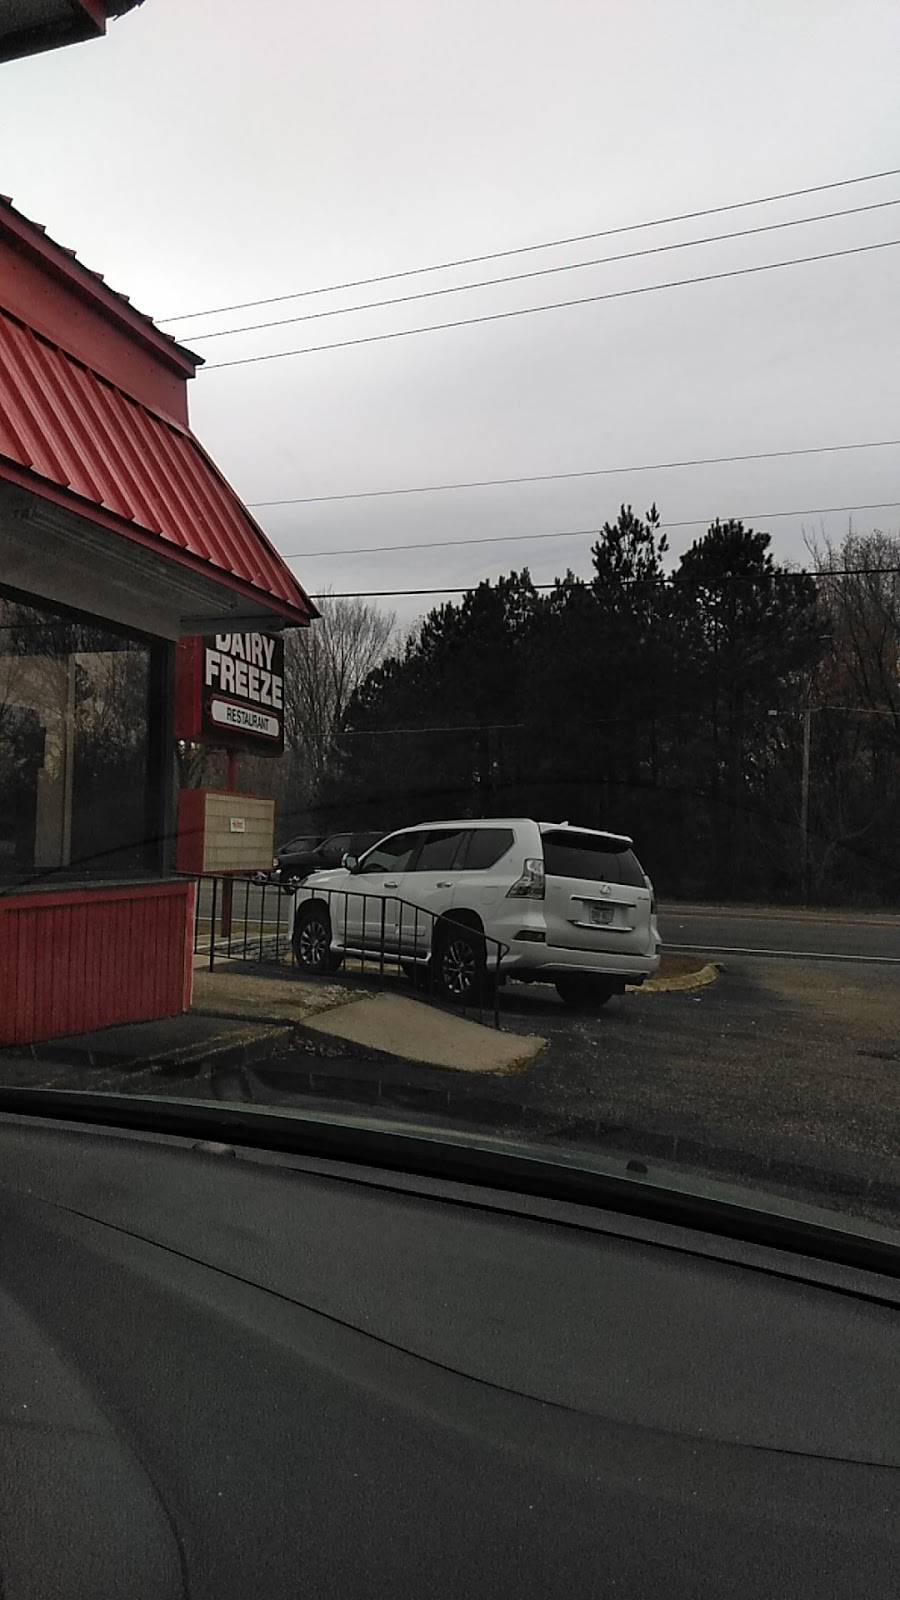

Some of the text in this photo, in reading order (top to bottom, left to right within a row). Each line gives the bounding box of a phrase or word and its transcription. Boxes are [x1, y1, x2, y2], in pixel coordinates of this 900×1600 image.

[215, 633, 275, 670] DAIRY
[205, 648, 283, 709] FREEZE
[226, 707, 270, 730] RESTAURANT
